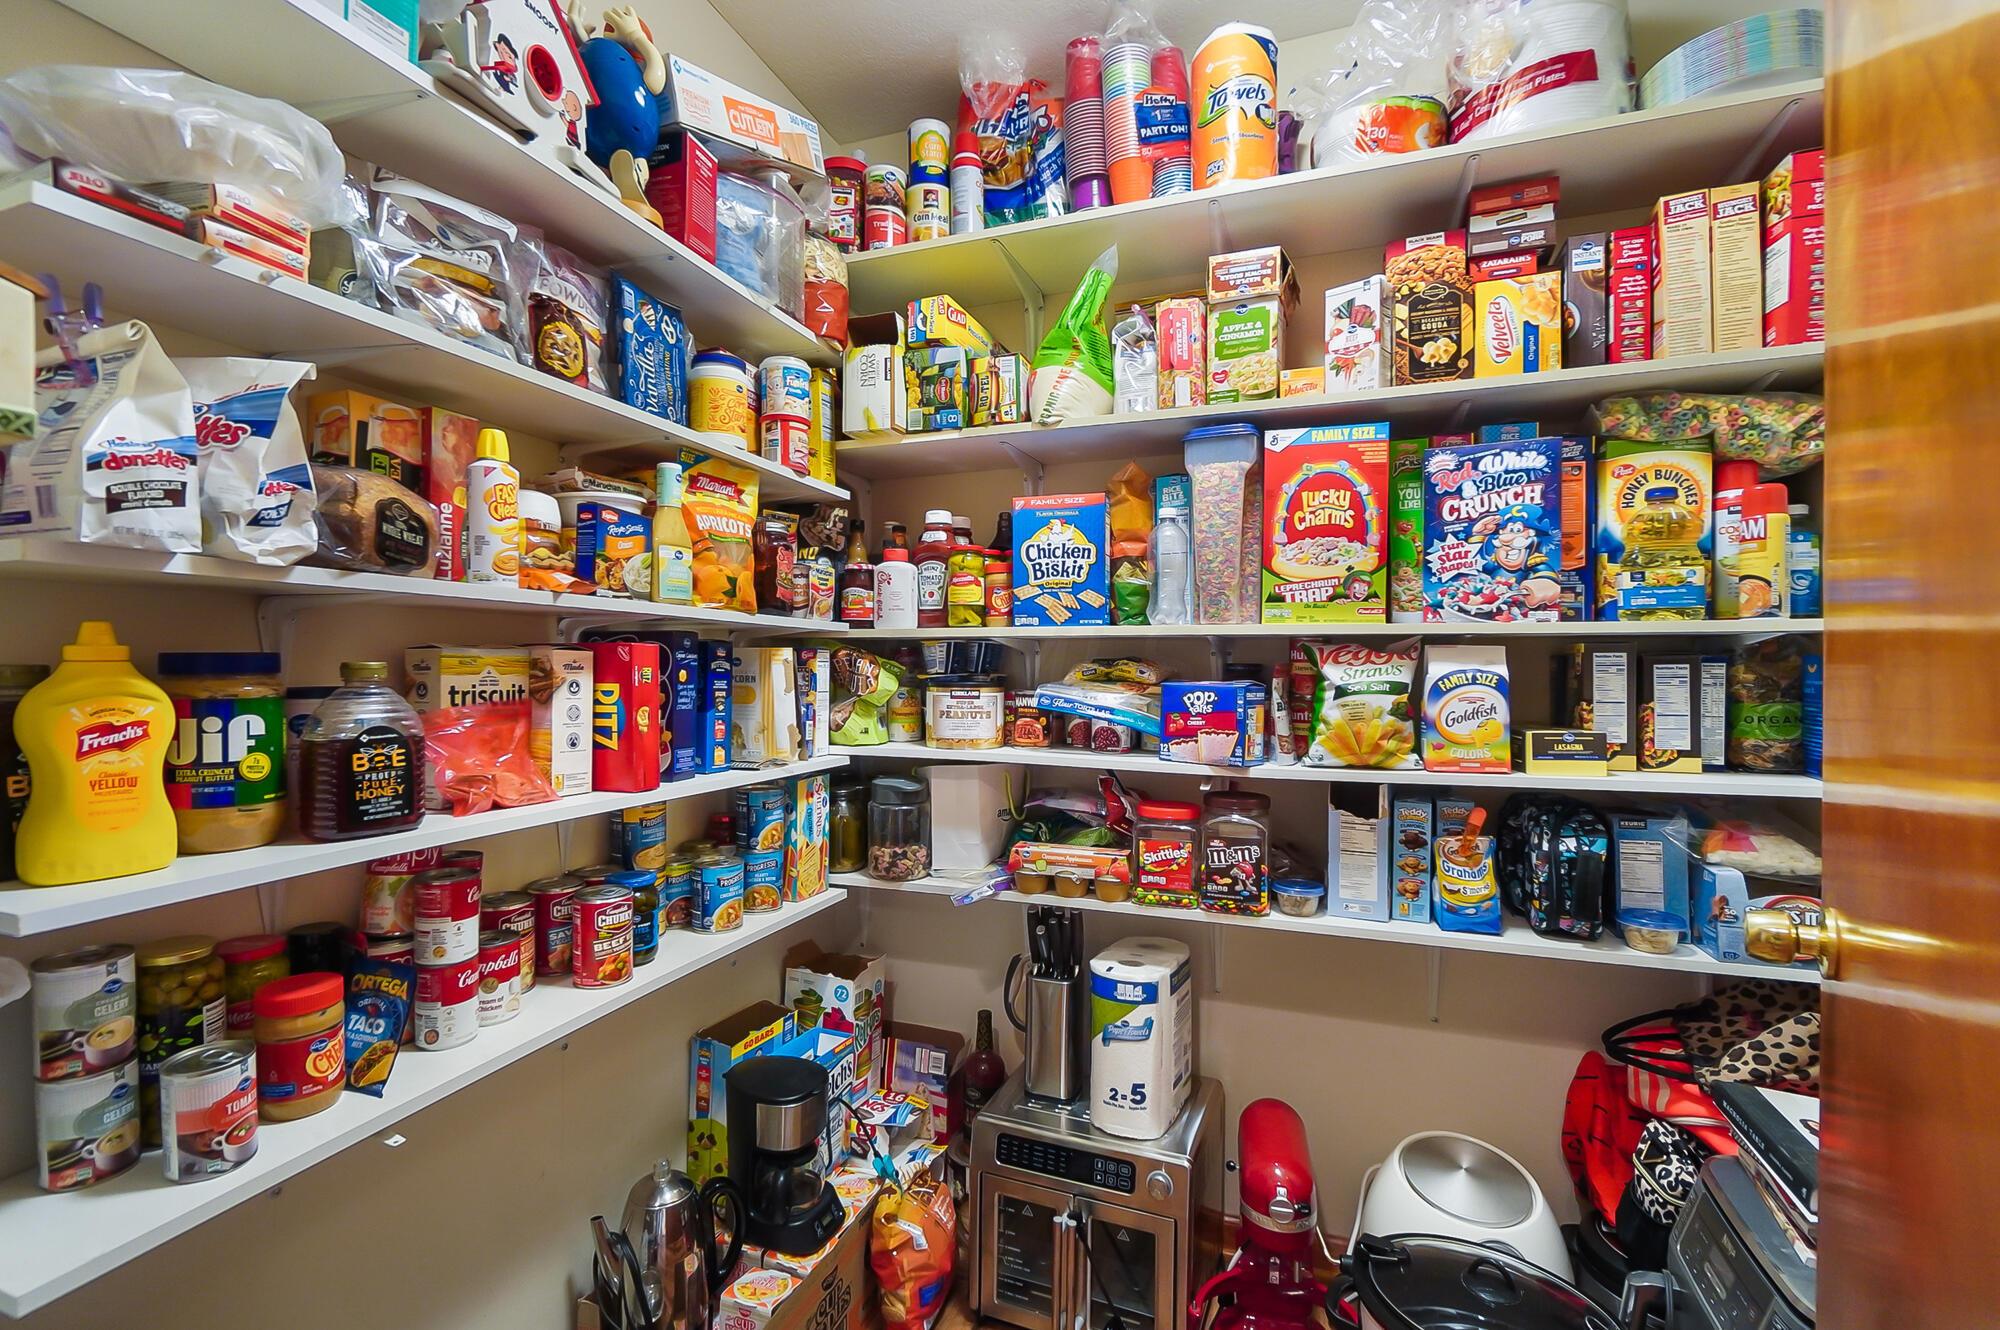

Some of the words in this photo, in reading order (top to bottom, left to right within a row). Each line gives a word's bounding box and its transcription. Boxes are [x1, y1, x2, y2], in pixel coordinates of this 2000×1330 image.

[524, 0, 560, 36] SNOOPY
[1535, 71, 1566, 87] Plates
[1145, 95, 1176, 106] Hefty
[729, 108, 775, 139] CUTLERY
[1140, 125, 1170, 138] PARTY
[1365, 127, 1387, 139] 130
[1668, 200, 1706, 215] JACK
[1716, 203, 1755, 218] JACK
[913, 214, 930, 222] Corn
[1617, 256, 1648, 264] PRODUCTS
[947, 308, 967, 325] GLAD
[1222, 323, 1254, 334] APPLE
[1421, 321, 1448, 331] GOUDA
[1487, 301, 1512, 359] Velveeta
[1219, 329, 1265, 341] CINNAMON
[1527, 335, 1535, 361] Original
[860, 354, 868, 388] CORN
[868, 354, 877, 388] SWEET
[1283, 382, 1318, 398] Velveeta
[1311, 428, 1350, 442] FAMILY
[1352, 427, 1376, 440] SIZE
[104, 450, 190, 471] donettes
[1479, 450, 1548, 473] White
[1614, 465, 1633, 477] Post
[589, 478, 622, 493] Maruchan
[697, 476, 736, 497] Mariani
[1479, 472, 1527, 493] Blue
[1621, 472, 1650, 509] HONEY
[1655, 469, 1698, 506] BUNCHES
[1030, 498, 1063, 506] FAMILY
[1064, 496, 1085, 504] SIZE
[1302, 488, 1351, 512] Lucky
[1399, 489, 1421, 500] YOU
[1441, 484, 1545, 521] CRUNCH
[696, 514, 752, 536] APRICOTS
[1293, 509, 1355, 531] Charms
[403, 530, 424, 547] WHEAT
[436, 503, 453, 580] Luzianne
[1025, 543, 1092, 561] Chicken
[1031, 560, 1085, 581] Biskit
[1274, 577, 1340, 592] LEPRECHAUN
[1282, 587, 1335, 603] TRAP
[562, 663, 585, 671] Made
[1340, 663, 1404, 681] Straws
[641, 667, 652, 684] RITZ
[734, 675, 756, 683] CORN
[1438, 671, 1473, 692] FAMILY
[1475, 671, 1500, 688] SIZE
[448, 683, 526, 707] triscuit
[951, 690, 980, 698] KIRKLAND
[1347, 683, 1368, 692] Sea
[1371, 683, 1391, 692] Salt
[594, 683, 620, 751] RITZ
[938, 710, 992, 719] PEANUTS
[1446, 702, 1498, 728] Goldfish
[80, 725, 147, 752] French's
[166, 714, 266, 766] Jif
[1160, 743, 1169, 753] 12
[1450, 748, 1492, 759] COLORS
[1554, 743, 1584, 751] LASAGNA
[175, 769, 197, 777] EXTRA
[198, 768, 235, 777] CRUNCHY
[89, 776, 138, 791] YELLOW
[363, 777, 397, 789] PURE
[356, 785, 405, 800] HONEY
[814, 782, 823, 837] SALTINES
[1399, 807, 1427, 817] Teddy
[1441, 806, 1470, 816] Teddy
[1620, 820, 1646, 828] KEURIG
[1143, 848, 1188, 864] Skittles
[747, 861, 776, 872] PROGRESSO
[1442, 860, 1488, 880] Grahams
[598, 909, 633, 927] CHUNKY
[594, 938, 624, 953] BEEF
[352, 973, 408, 1000] ORTEGA
[836, 988, 847, 999] 72
[94, 997, 130, 1018] CELERY
[479, 998, 497, 1007] ream
[348, 1014, 386, 1034] TACO
[1108, 1025, 1126, 1034] Paper
[1127, 1027, 1149, 1036] Towels
[744, 1038, 754, 1049] GO
[754, 1028, 774, 1046] BARS
[885, 1094, 903, 1102] 16
[1109, 1088, 1118, 1101] 2
[1130, 1083, 1147, 1105] 5
[103, 1102, 135, 1123] CELERY
[1749, 1127, 1766, 1150] TABLE
